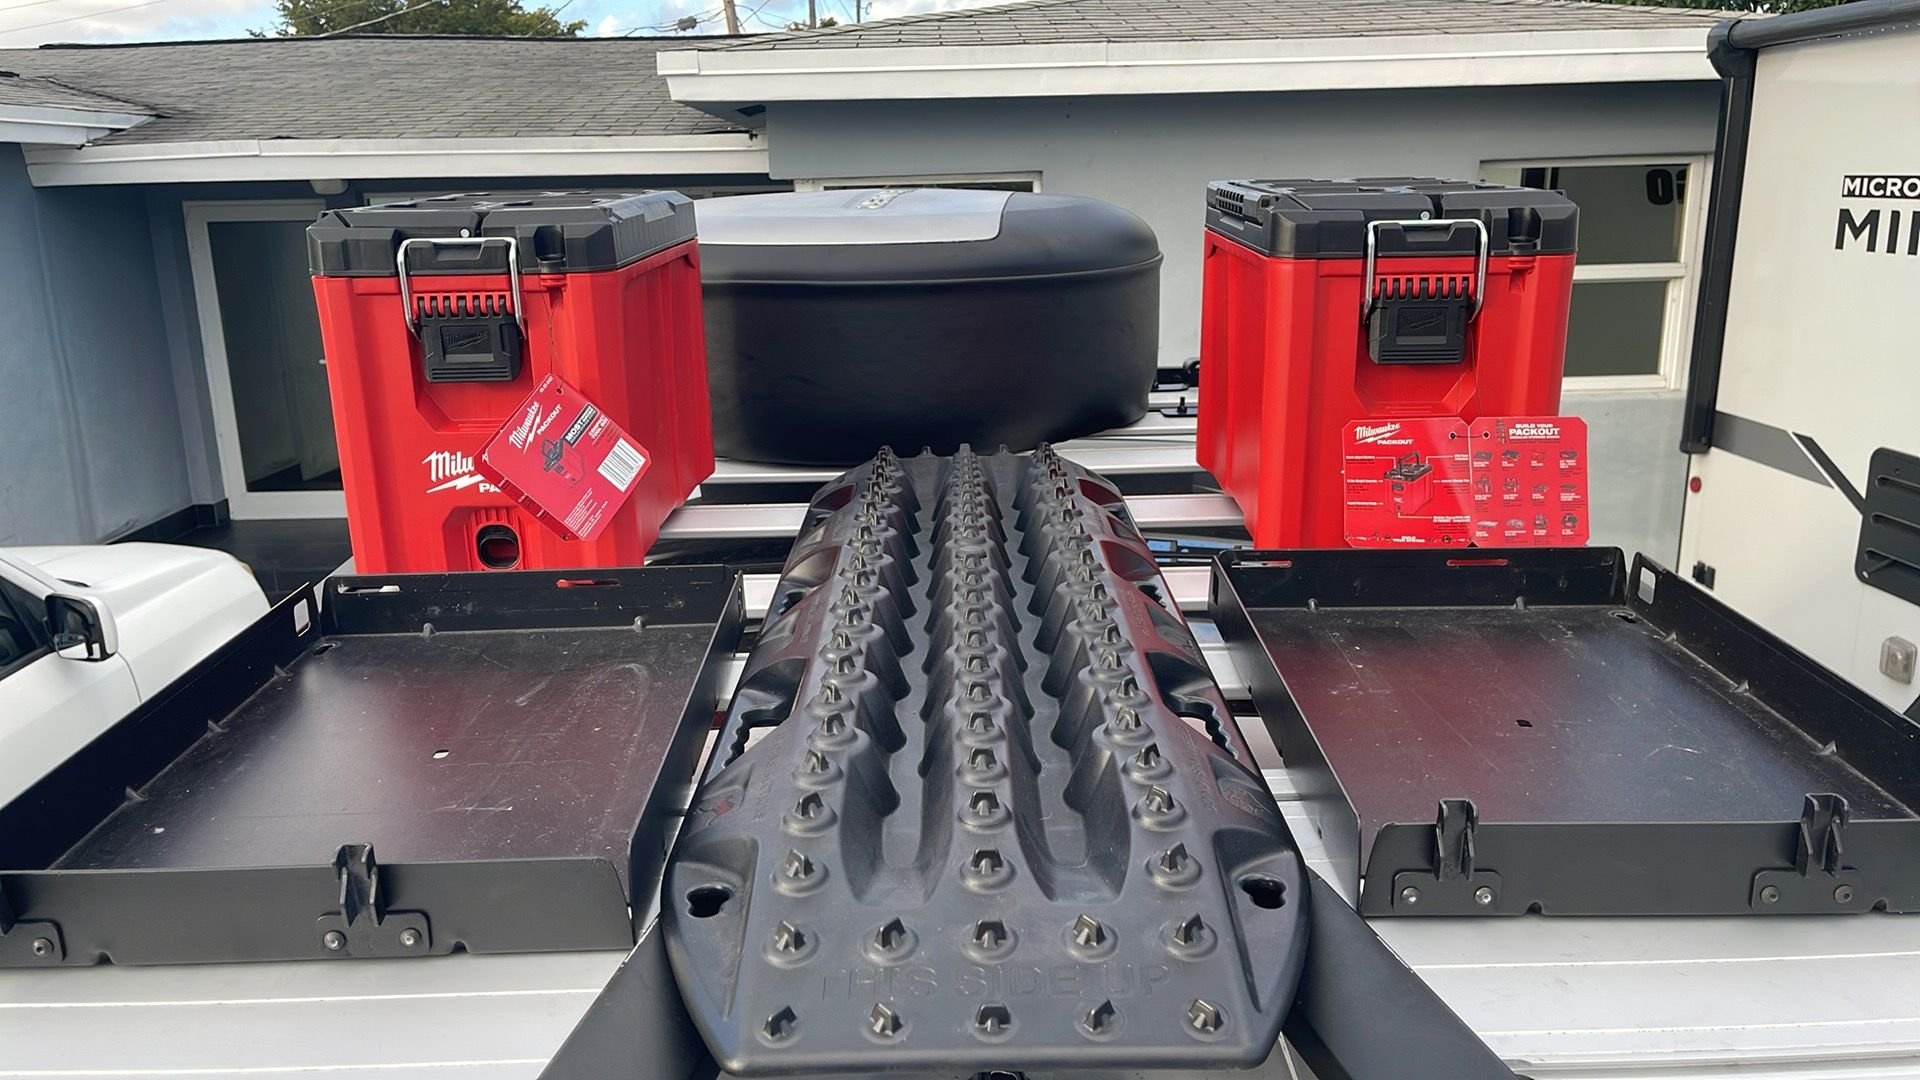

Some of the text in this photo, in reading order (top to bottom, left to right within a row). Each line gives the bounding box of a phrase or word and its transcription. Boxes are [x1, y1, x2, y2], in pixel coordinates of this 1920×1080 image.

[1843, 177, 1920, 198] MICRO
[536, 403, 562, 436] PACKOUT
[1354, 422, 1401, 440] Milwaukee
[1509, 428, 1560, 436] PACKOUT
